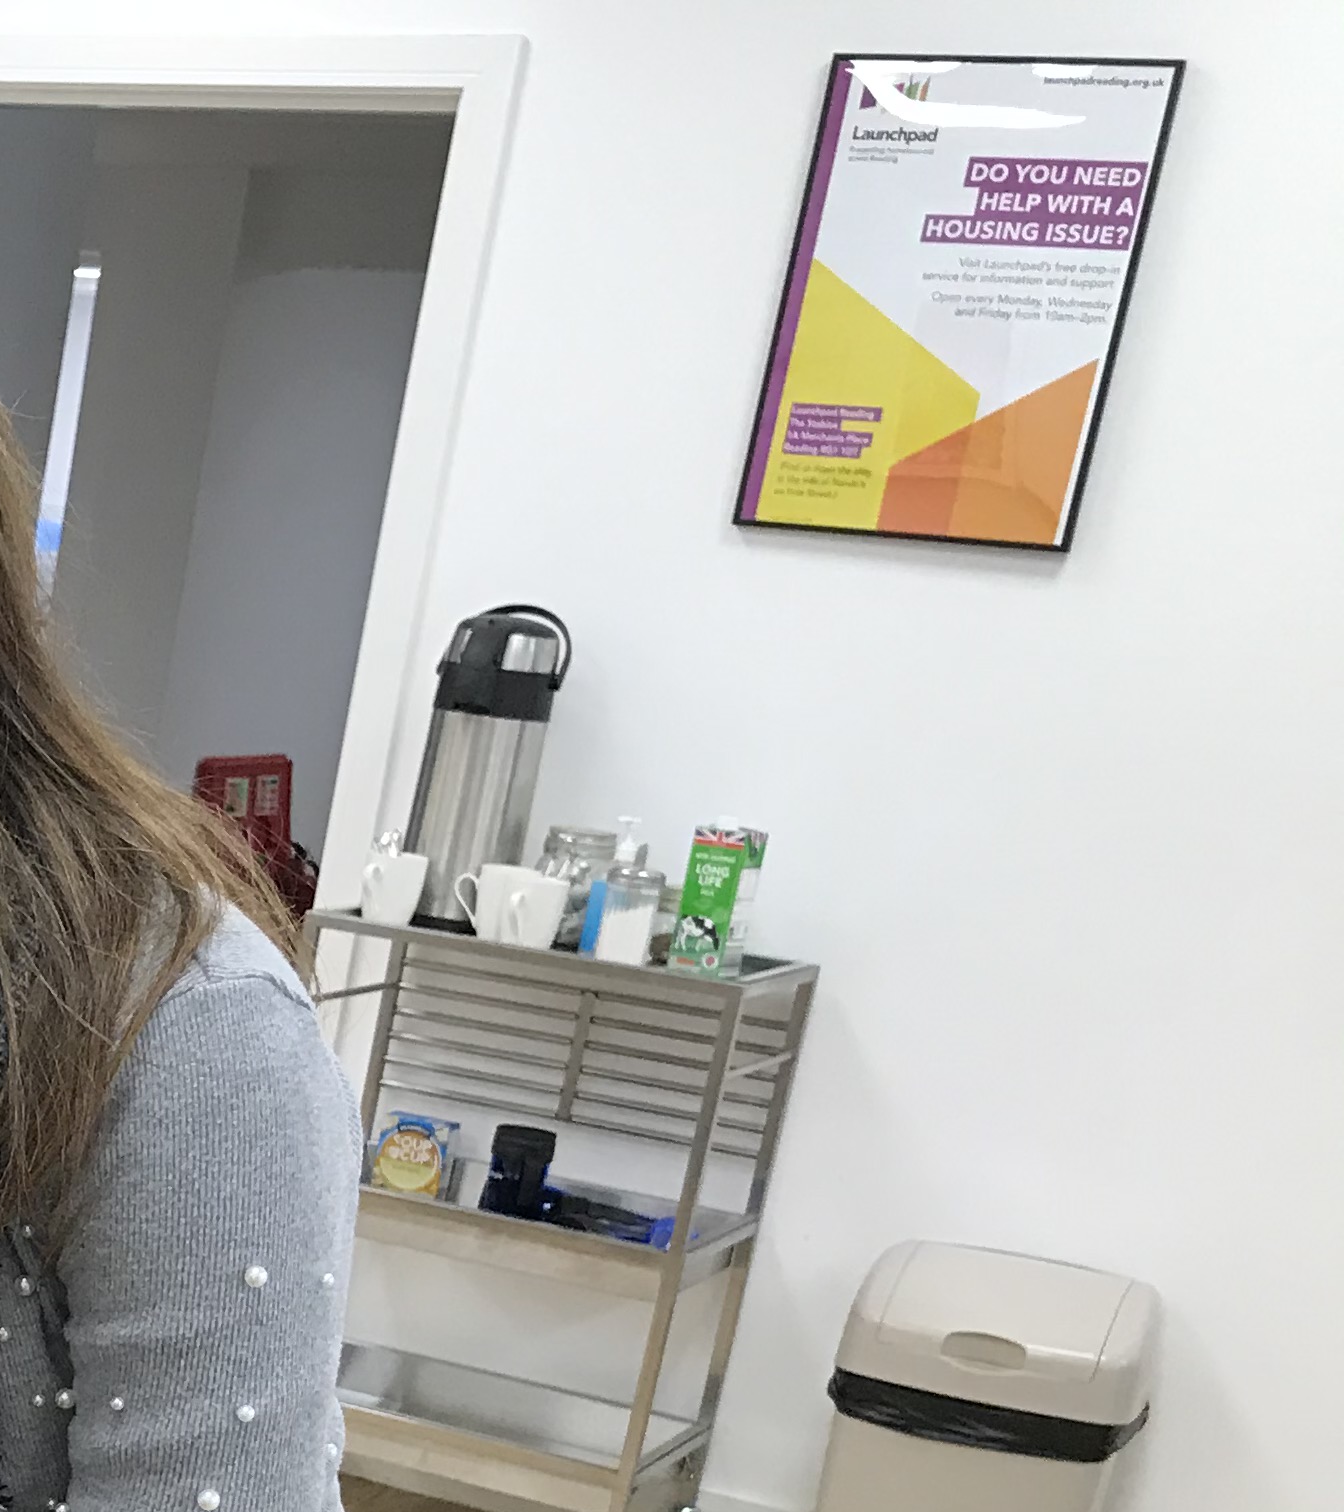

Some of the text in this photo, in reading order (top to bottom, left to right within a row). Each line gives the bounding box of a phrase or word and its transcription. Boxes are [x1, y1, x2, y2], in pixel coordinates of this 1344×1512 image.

[851, 124, 940, 146] Launchpad
[970, 162, 1142, 187] DO YOU NEED
[979, 191, 1135, 217] HELP WITH A
[924, 218, 1130, 245] HOUSING ISSUE?
[695, 862, 731, 880] LONG
[697, 874, 725, 890] LIFE
